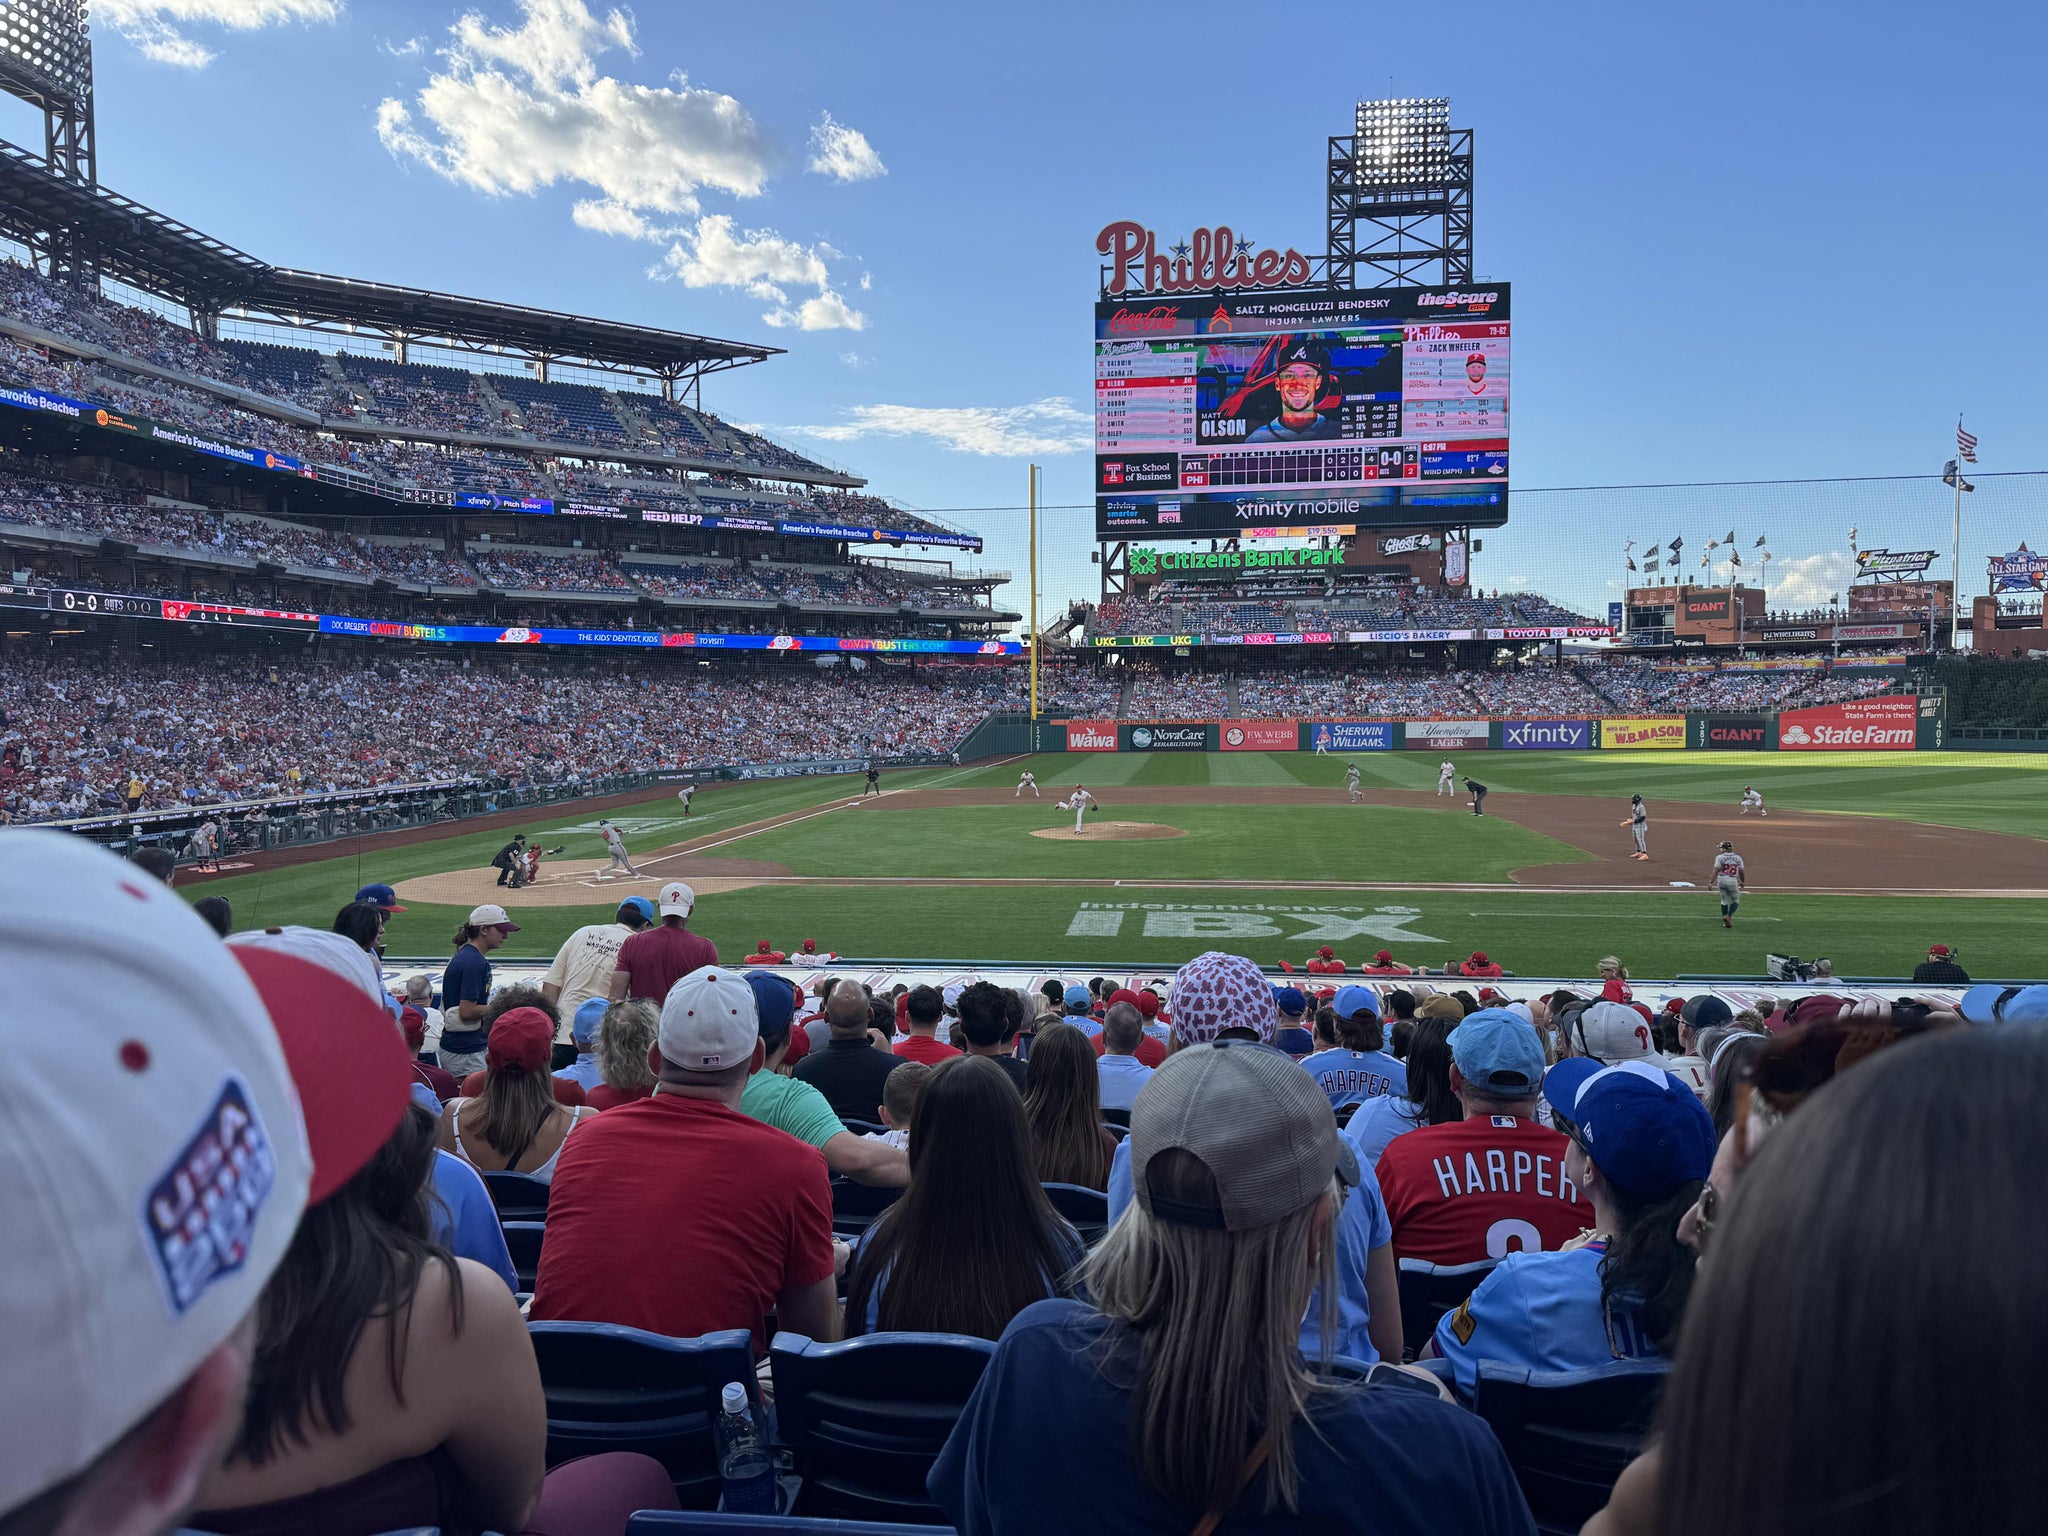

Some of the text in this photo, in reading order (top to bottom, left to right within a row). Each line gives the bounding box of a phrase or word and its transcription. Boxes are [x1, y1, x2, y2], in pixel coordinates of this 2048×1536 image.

[1096, 221, 1310, 295] Phillies
[1417, 291, 1499, 307] theScore
[1235, 299, 1391, 315] SALTZ MONGELUZZI BENDESKY
[1110, 306, 1180, 333] Coca-Cola
[1265, 314, 1360, 326] INJURY LAWYERS
[1403, 326, 1460, 342] Phillies
[1100, 340, 1145, 357] Braves
[1428, 343, 1447, 352] ZACK
[1448, 342, 1480, 352] WHEELER
[1107, 359, 1132, 367] BALDWIN
[0, 386, 80, 417] avorite Beaches
[1201, 418, 1247, 437] OLSON
[152, 426, 254, 461] America's Favorite Beaches
[1423, 442, 1446, 451] 6:07 PM
[1185, 461, 1204, 471] ATL
[1340, 456, 1346, 464] 2
[1380, 451, 1401, 466] 0-0
[1125, 463, 1170, 472] Fox School
[1125, 473, 1172, 482] of Business
[1186, 476, 1203, 485] PHI
[467, 496, 491, 507] xfinity
[503, 500, 541, 509] Pitch Speed
[1107, 502, 1136, 511] Driving
[1106, 510, 1139, 518] smarter
[1235, 498, 1360, 519] xfinity mobile
[642, 510, 703, 525] NEED HELP?
[1106, 518, 1149, 526] outcomes.
[782, 523, 868, 538] America's Favorite Beaches
[905, 533, 934, 544] America's
[934, 536, 958, 545] Favorite
[958, 538, 981, 547] Beaches
[1385, 534, 1421, 553] GHOST
[1160, 546, 1345, 570] Citizens Bank Park
[1863, 550, 1930, 567] Fitzpatrick
[1988, 561, 2048, 574] ALL STAR GAM
[104, 598, 124, 611] OUTS
[1688, 602, 1726, 612] GIANT
[331, 620, 368, 632] DOC BRESLER'S
[369, 622, 446, 639] CAVITY BUSTERS
[1570, 628, 1611, 636] TOYOTA
[578, 633, 593, 641] THE
[612, 635, 642, 643] DENTIST,
[642, 635, 658, 643] KIDS
[662, 633, 696, 646] LOVE
[1246, 635, 1273, 643] NECA
[1305, 634, 1332, 642] NECA
[1369, 631, 1450, 641] LISCIO'S BAKERY
[1507, 629, 1547, 638] TOYOTA
[700, 637, 708, 645] TO
[839, 639, 944, 651] CAVITYBUSTERS.COM
[1095, 637, 1117, 647] UKG
[1132, 636, 1154, 646] UKG
[1170, 635, 1192, 645] UKG
[1863, 703, 1881, 711] good
[1882, 703, 1914, 711] neighbor,
[1920, 698, 1941, 708] MONTY'S
[1920, 707, 1937, 717] ANGLE
[1153, 729, 1205, 740] NovaCare
[1264, 730, 1294, 739] WEBB
[1333, 725, 1383, 736] SHERWIN
[1421, 723, 1473, 736] Yuengling
[1508, 723, 1583, 745] xfinity
[1710, 728, 1765, 741] GIANT
[1069, 733, 1117, 748] Wawa
[1332, 736, 1385, 748] WILLIAMS.
[1430, 738, 1464, 747] LAGER
[671, 891, 680, 902] P
[1080, 901, 1365, 914] Independence
[1064, 910, 1450, 944] IBX
[588, 934, 622, 947] HYRO
[586, 941, 619, 953] WASHINGT
[1635, 1026, 1648, 1050] P
[1322, 1068, 1391, 1097] HARPER
